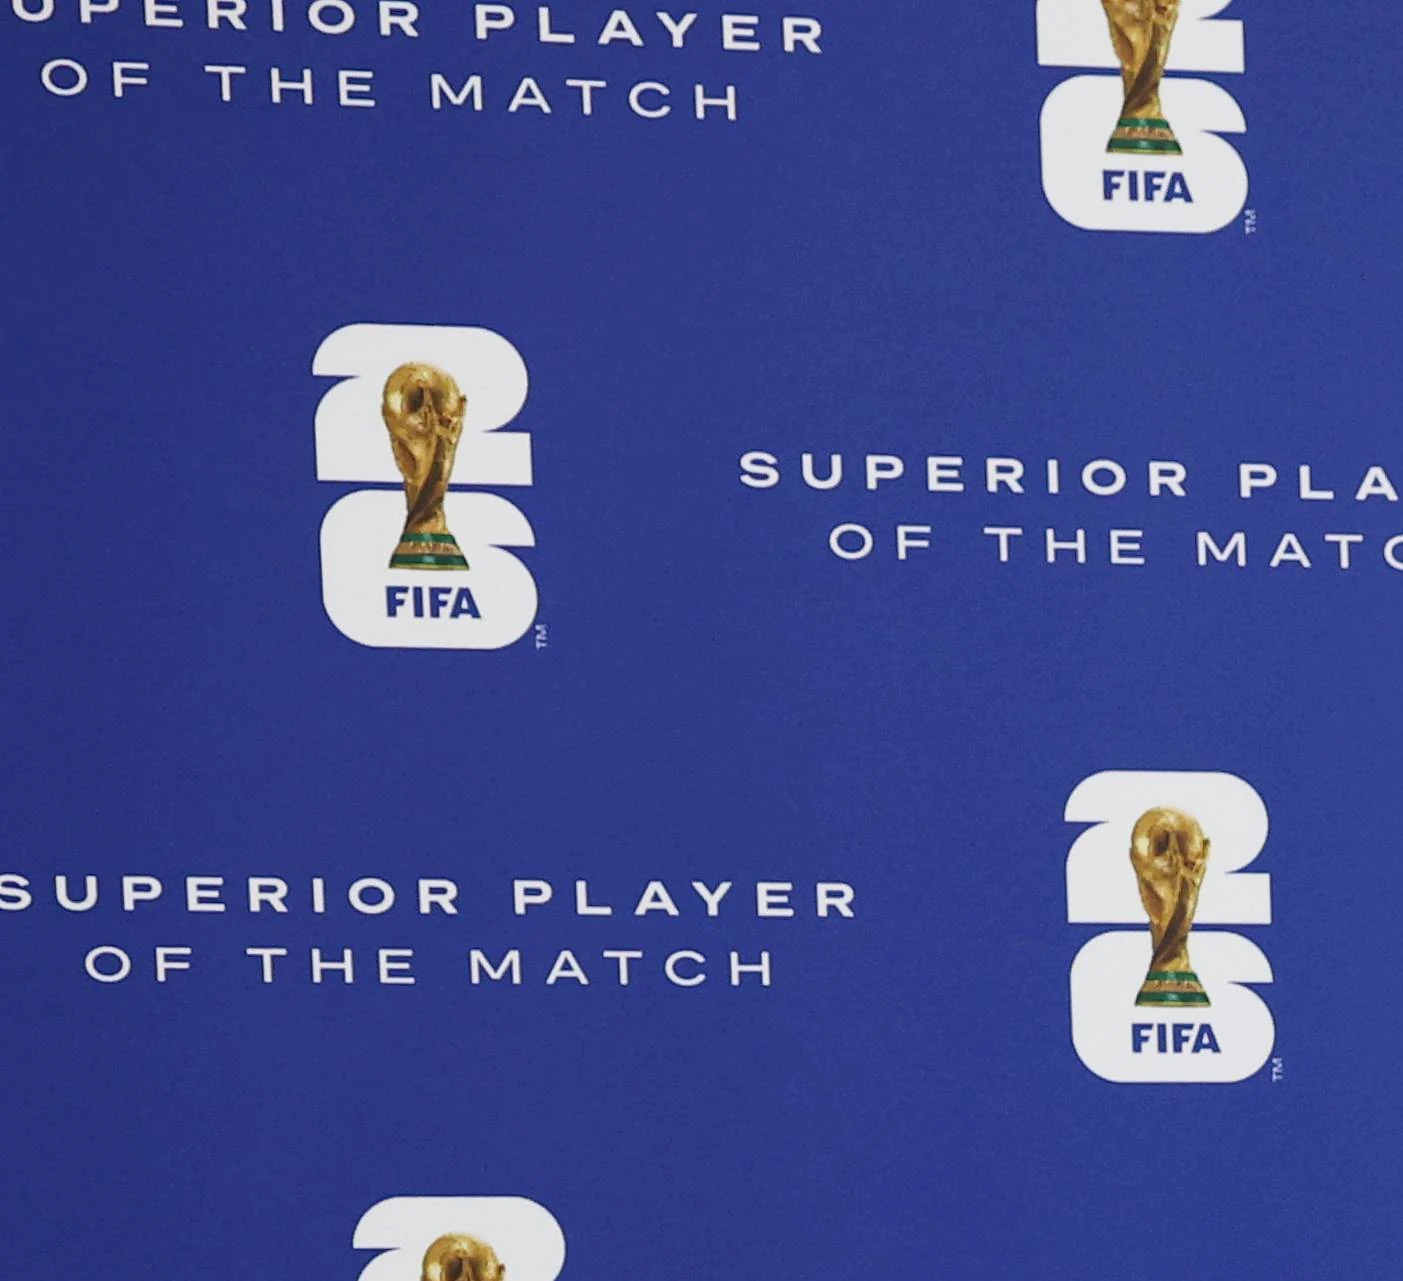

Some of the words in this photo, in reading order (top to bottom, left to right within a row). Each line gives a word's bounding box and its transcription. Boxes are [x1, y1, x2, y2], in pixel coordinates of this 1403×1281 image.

[11, 0, 420, 38] UPERIOR
[474, 3, 823, 55] PLAYER
[40, 58, 150, 98] OF
[203, 64, 376, 108] THE
[430, 73, 737, 122] MATCH
[1101, 169, 1194, 204] FIFA
[739, 450, 1187, 498] SUPERIOR
[828, 522, 932, 561] OF
[982, 526, 1146, 566] THE
[385, 585, 482, 620] FIFA
[0, 873, 459, 915] SUPERIOR
[513, 879, 855, 918] PLAYER
[84, 945, 193, 983] OF
[245, 947, 416, 985] THE
[469, 948, 772, 987] MATCH
[1131, 1022, 1222, 1054] FIFA
